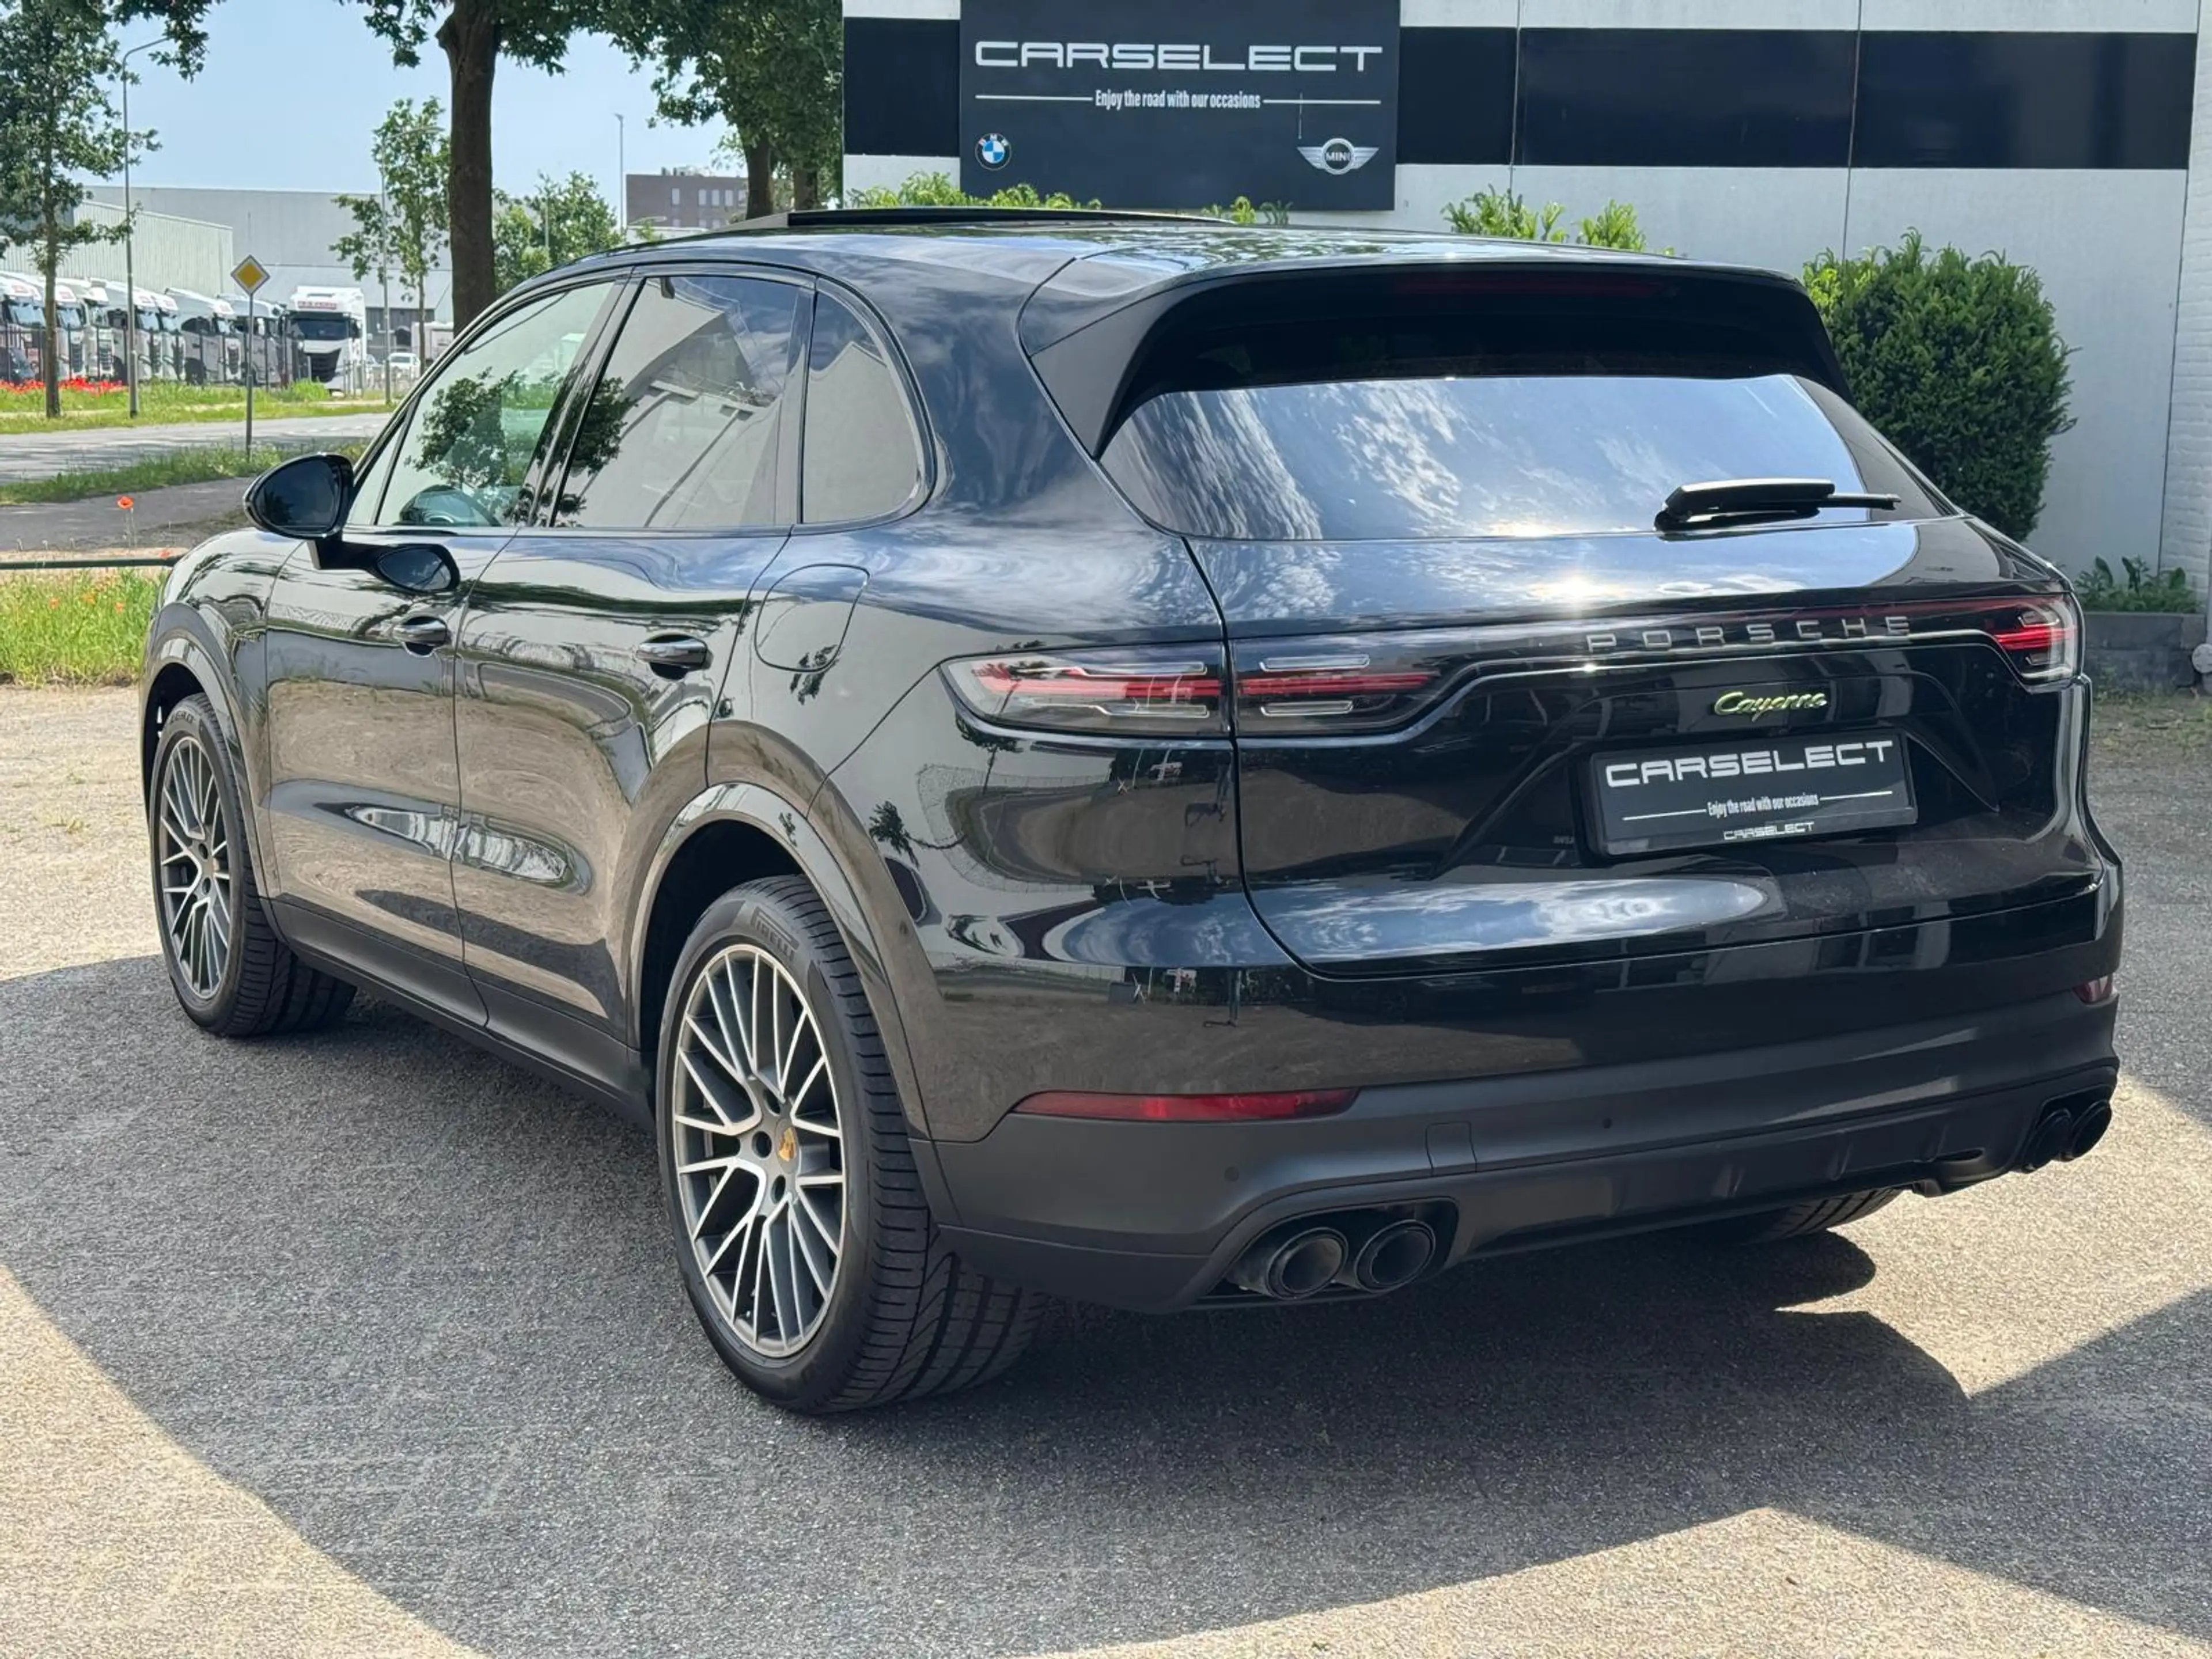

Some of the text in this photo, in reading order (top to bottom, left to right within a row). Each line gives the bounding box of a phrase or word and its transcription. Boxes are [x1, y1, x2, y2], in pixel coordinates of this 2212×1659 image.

[975, 41, 1382, 72] CARSELECT
[1095, 89, 1260, 111] Enjoy the road with our occasions
[1326, 151, 1351, 161] MINI
[1586, 616, 1911, 653] PORSCHE
[1714, 691, 1828, 722] Cayenne
[1605, 740, 1893, 787] CARSELECT
[1707, 801, 1728, 819] Enjoy
[1726, 799, 1740, 815] the
[1739, 797, 1756, 813] road
[1724, 821, 1815, 840] CARSELECT
